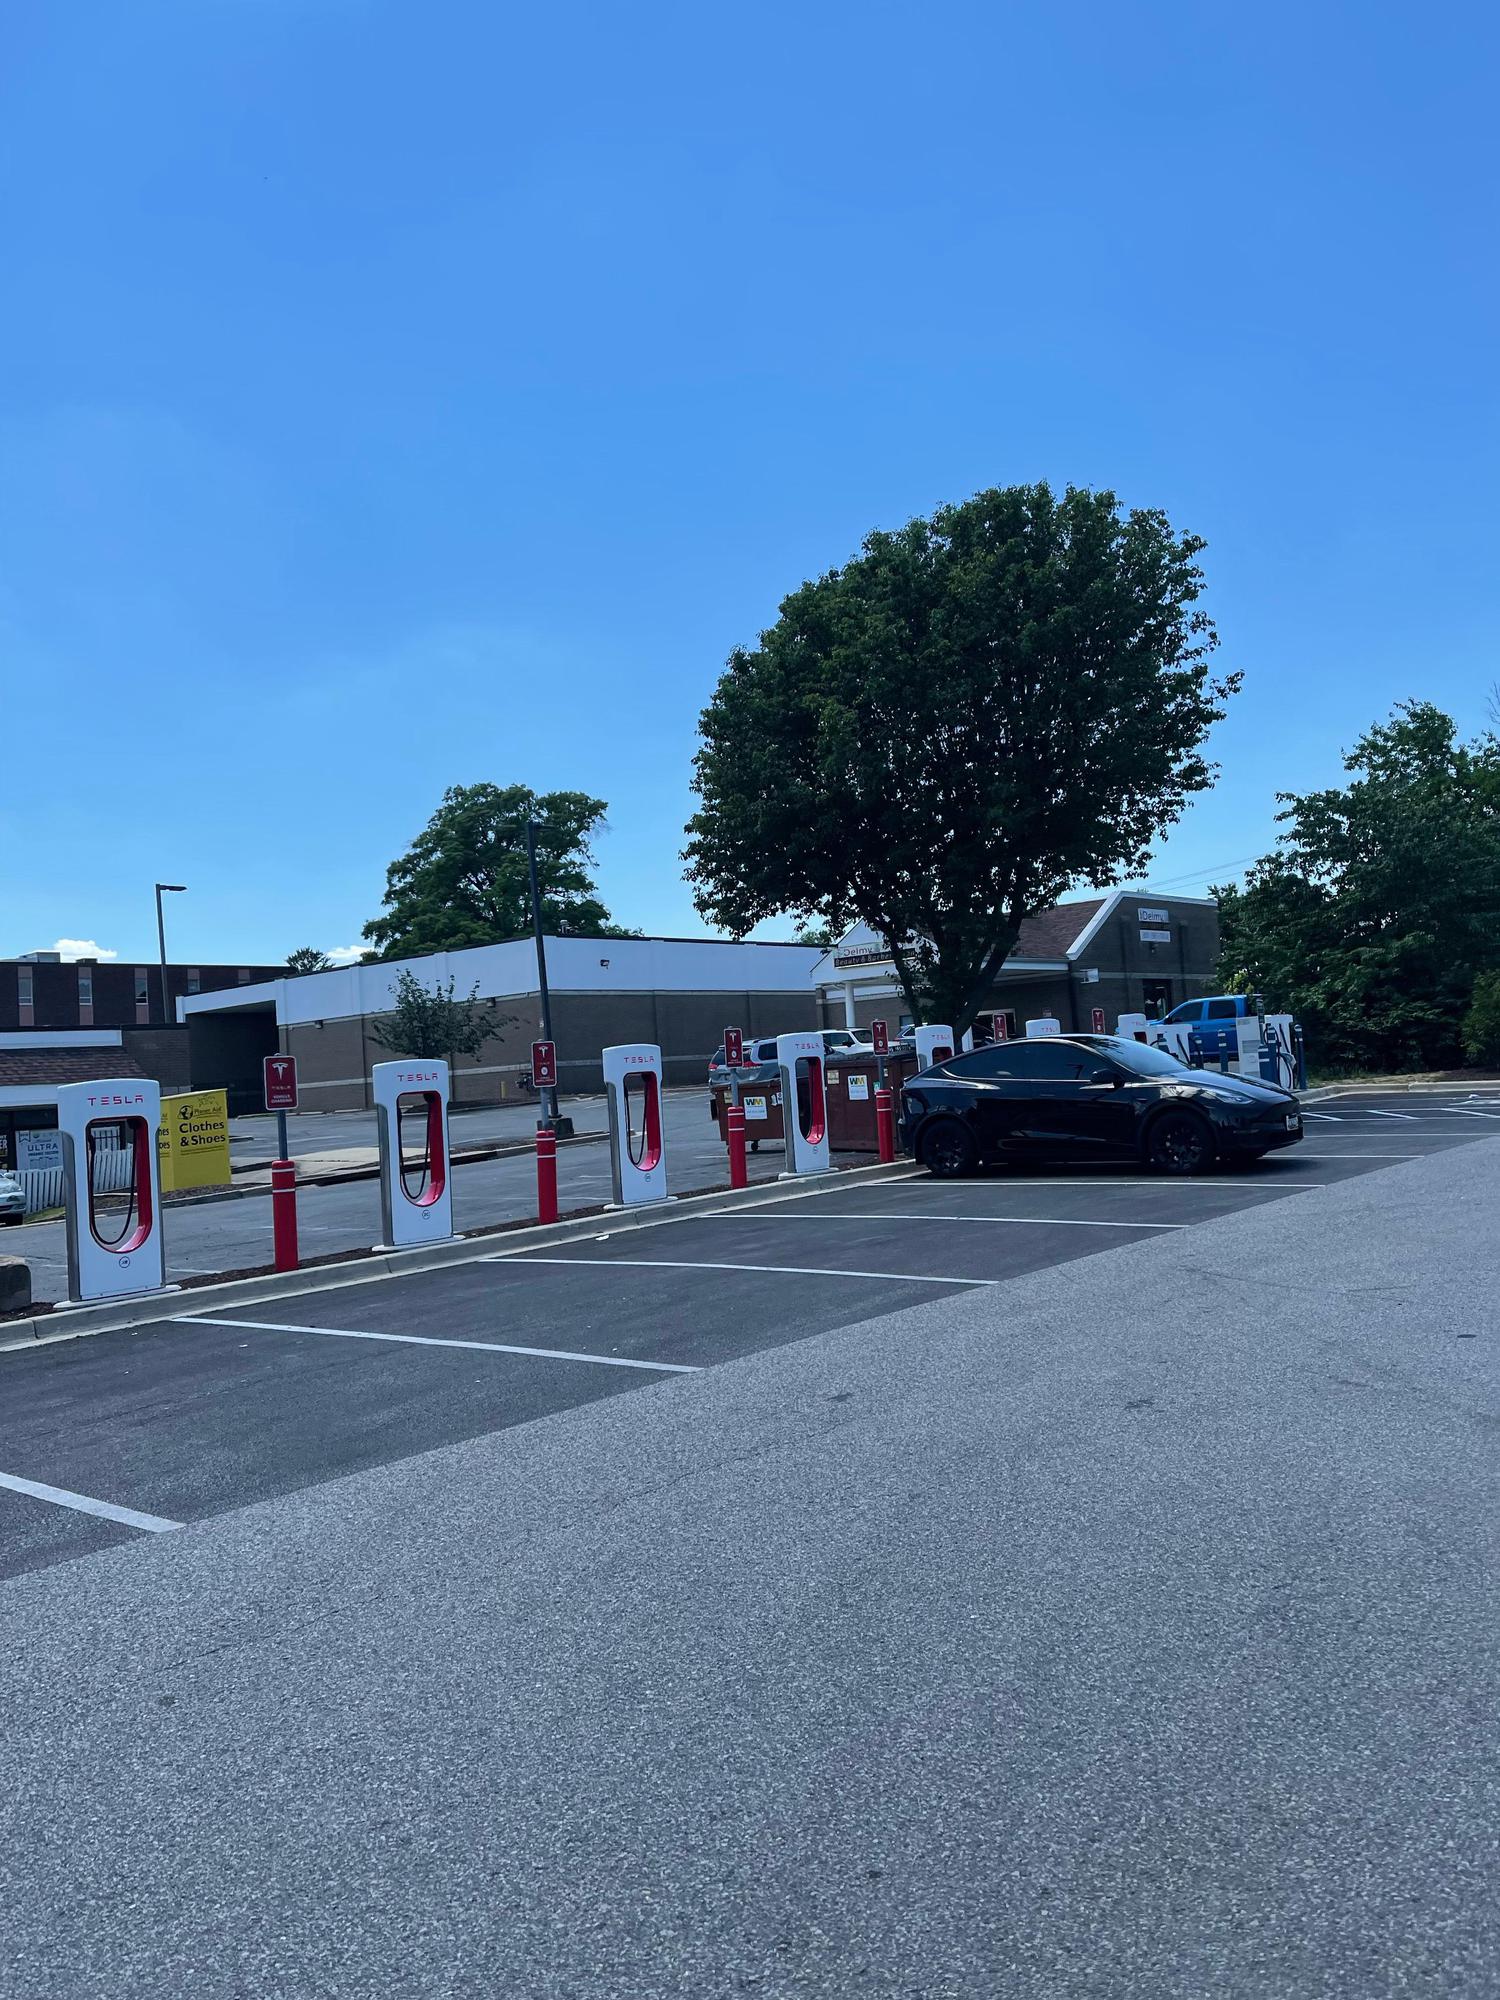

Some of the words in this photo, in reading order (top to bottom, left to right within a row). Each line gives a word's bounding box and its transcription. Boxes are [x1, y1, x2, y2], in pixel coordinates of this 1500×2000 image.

[623, 1055, 654, 1064] TESLA
[397, 1072, 439, 1082] TESLA
[87, 1094, 144, 1106] TESLA
[745, 1098, 764, 1106] WM
[179, 1121, 225, 1133] Clothes
[180, 1136, 189, 1147] &
[191, 1134, 226, 1146] Shoes
[27, 1143, 58, 1152] ULTRA
